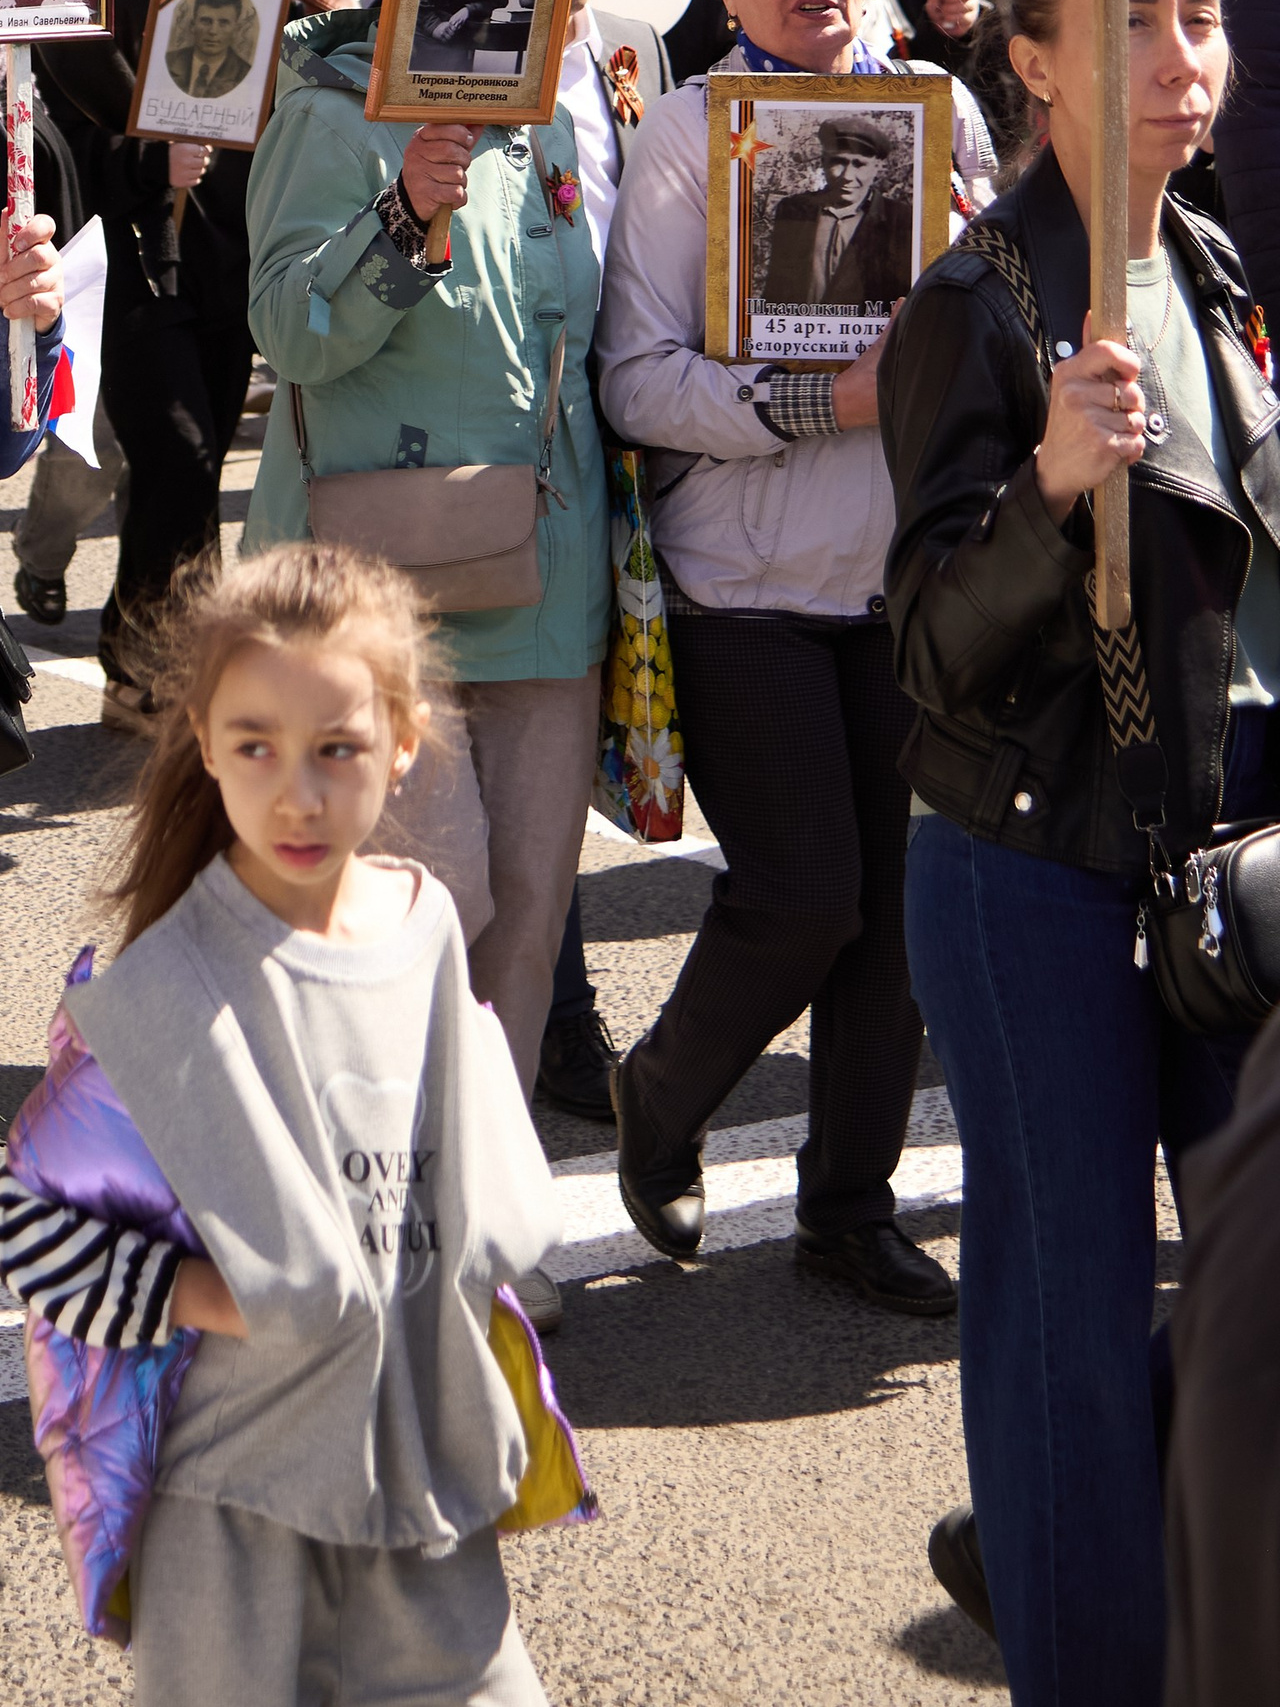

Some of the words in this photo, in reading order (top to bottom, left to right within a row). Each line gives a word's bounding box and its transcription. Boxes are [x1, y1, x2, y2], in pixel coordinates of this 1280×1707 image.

[7, 18, 29, 27] Иван
[32, 15, 85, 27] Савельевич
[412, 73, 519, 88] Петрова-Боровикова
[418, 88, 453, 100] Мария
[455, 90, 508, 102] Сергеевна
[145, 97, 256, 128] БУДАРНЫЙ
[746, 298, 859, 317] Штатолкин
[765, 319, 787, 334] 45
[794, 322, 832, 338] арт.
[743, 337, 849, 356] Белорусский
